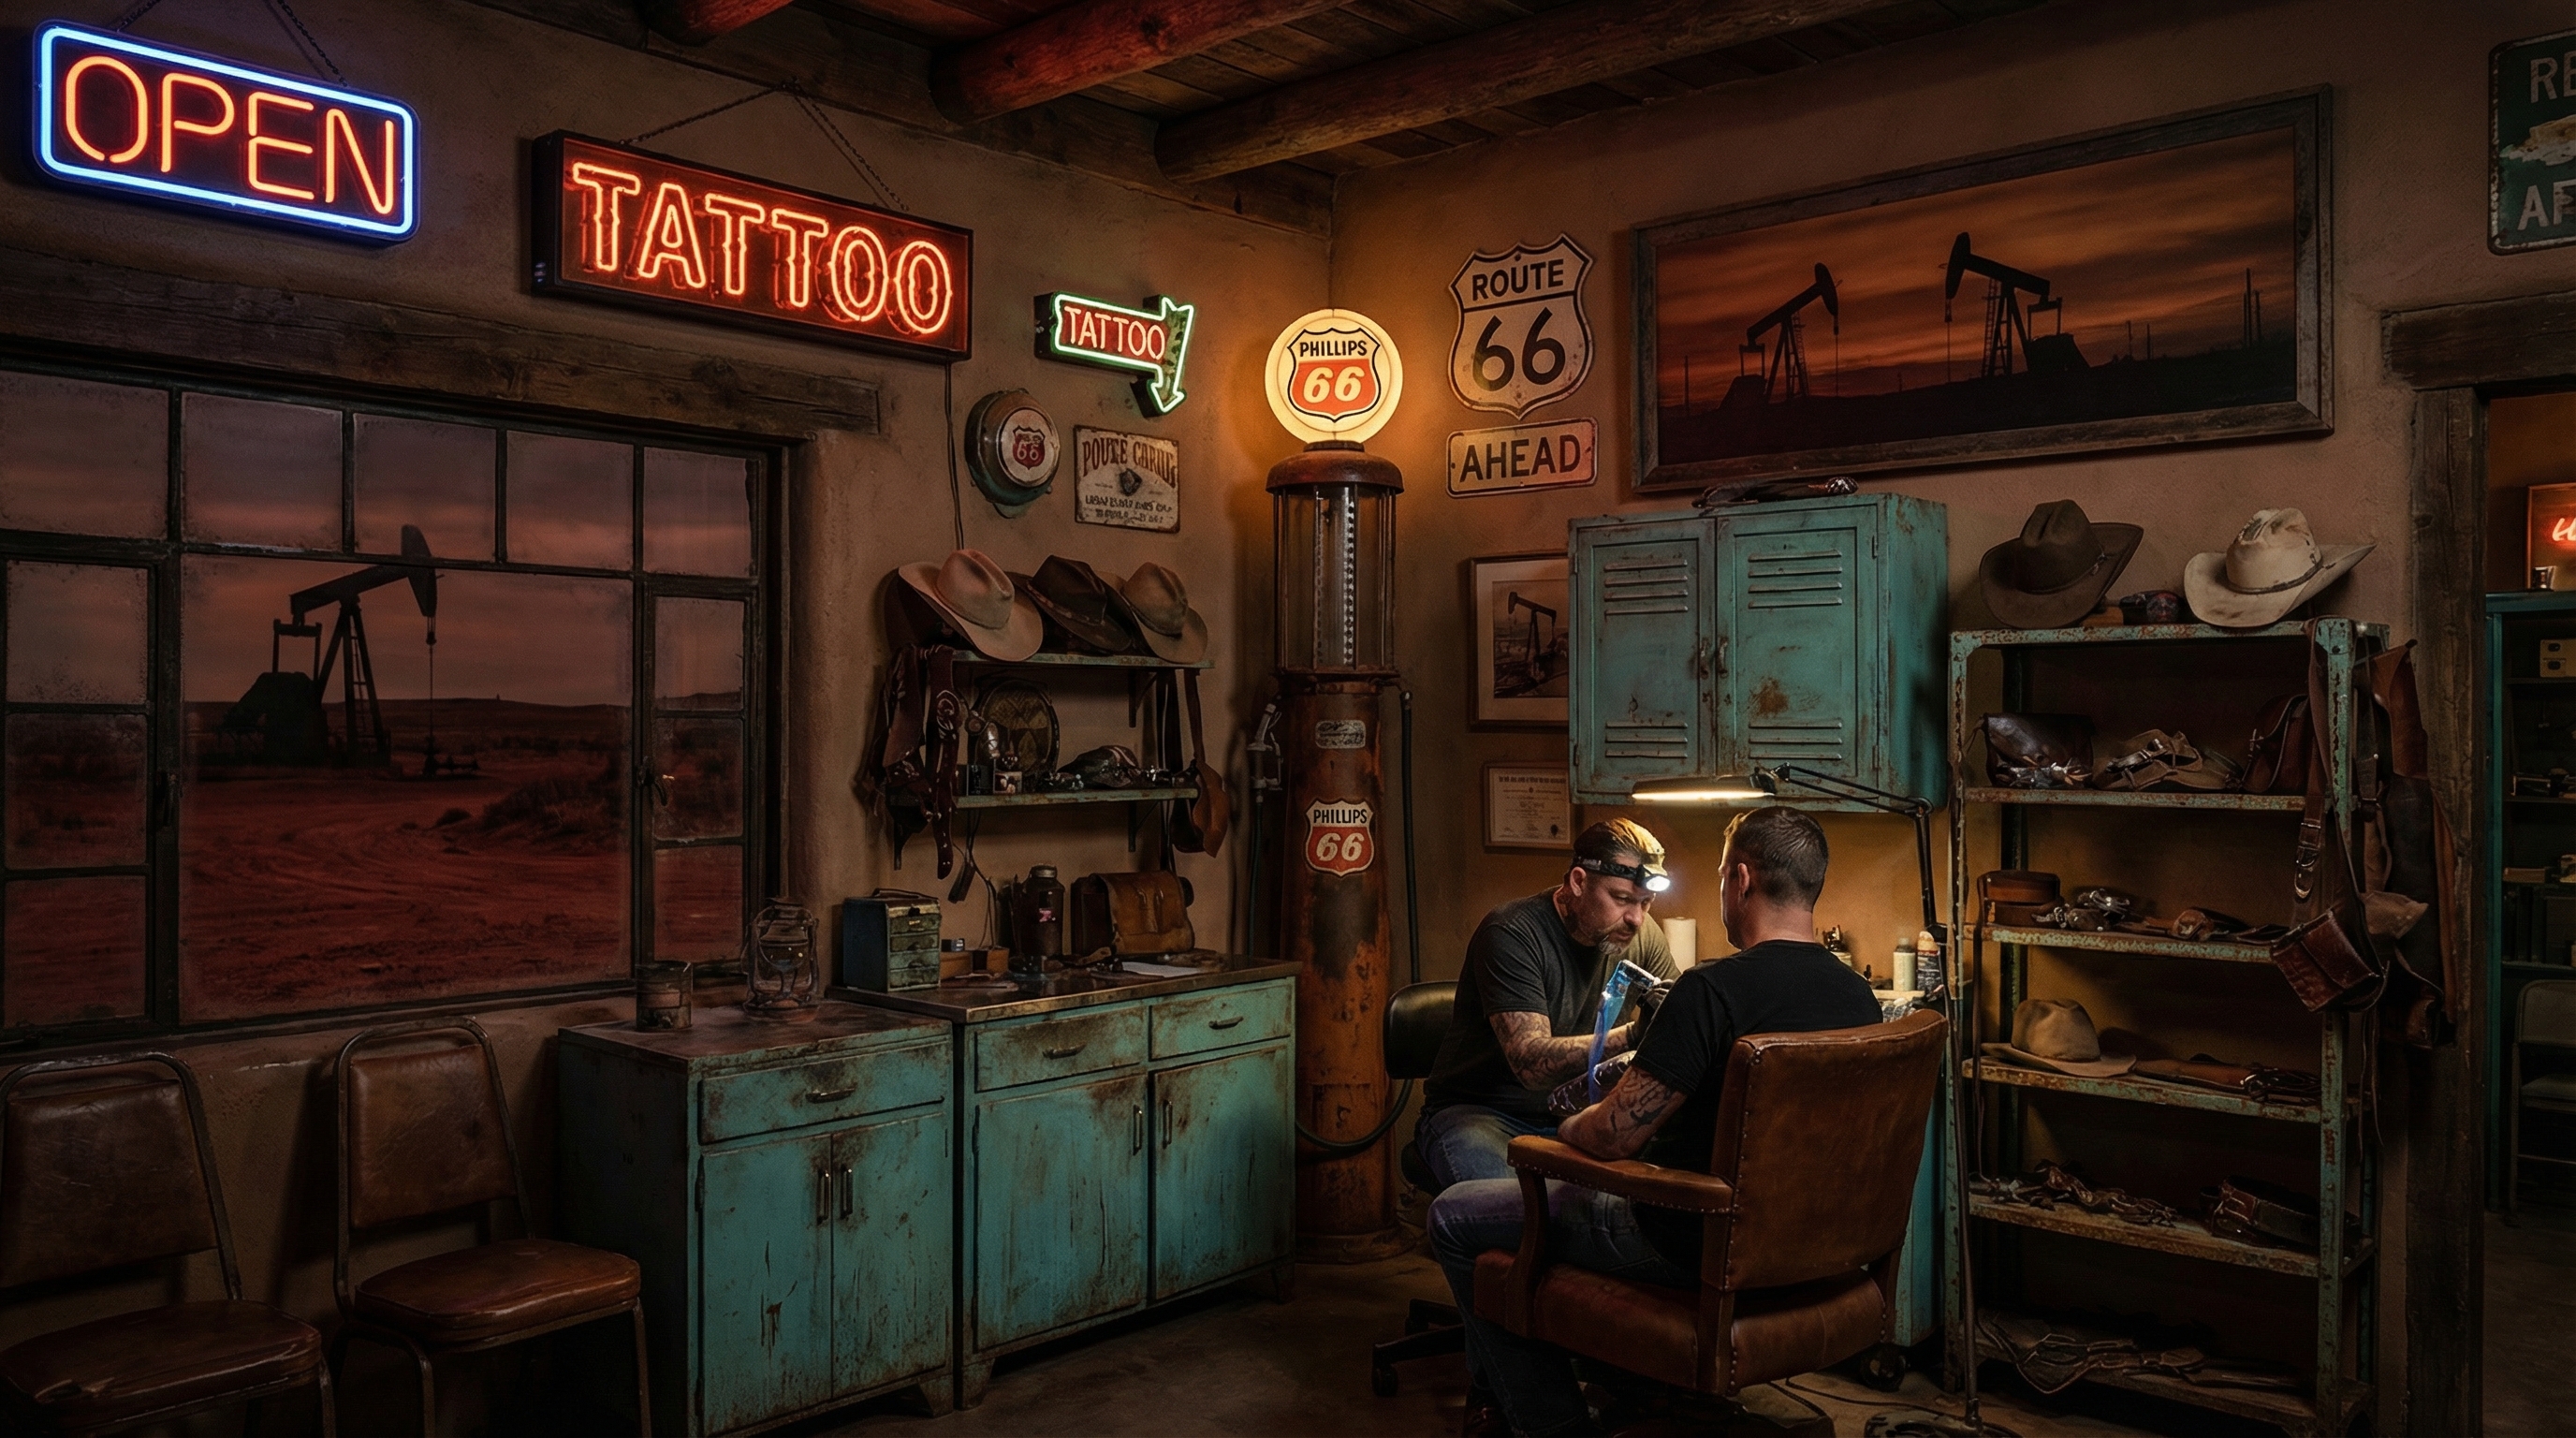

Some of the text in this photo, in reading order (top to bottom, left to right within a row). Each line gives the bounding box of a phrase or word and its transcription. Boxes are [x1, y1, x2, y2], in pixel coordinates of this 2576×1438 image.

[65, 55, 395, 215] OPEN
[572, 162, 953, 334] TATTOO
[1471, 258, 1564, 302] ROUTE
[1063, 305, 1165, 360] TATTOO
[1299, 340, 1368, 358] PHILLIPS
[1472, 306, 1566, 392] 66
[1303, 366, 1366, 404] 66
[1017, 442, 1039, 461] 66
[1459, 434, 1581, 483] AHEAD
[1313, 809, 1368, 824] PHILLIPS
[1316, 832, 1365, 862] 66
